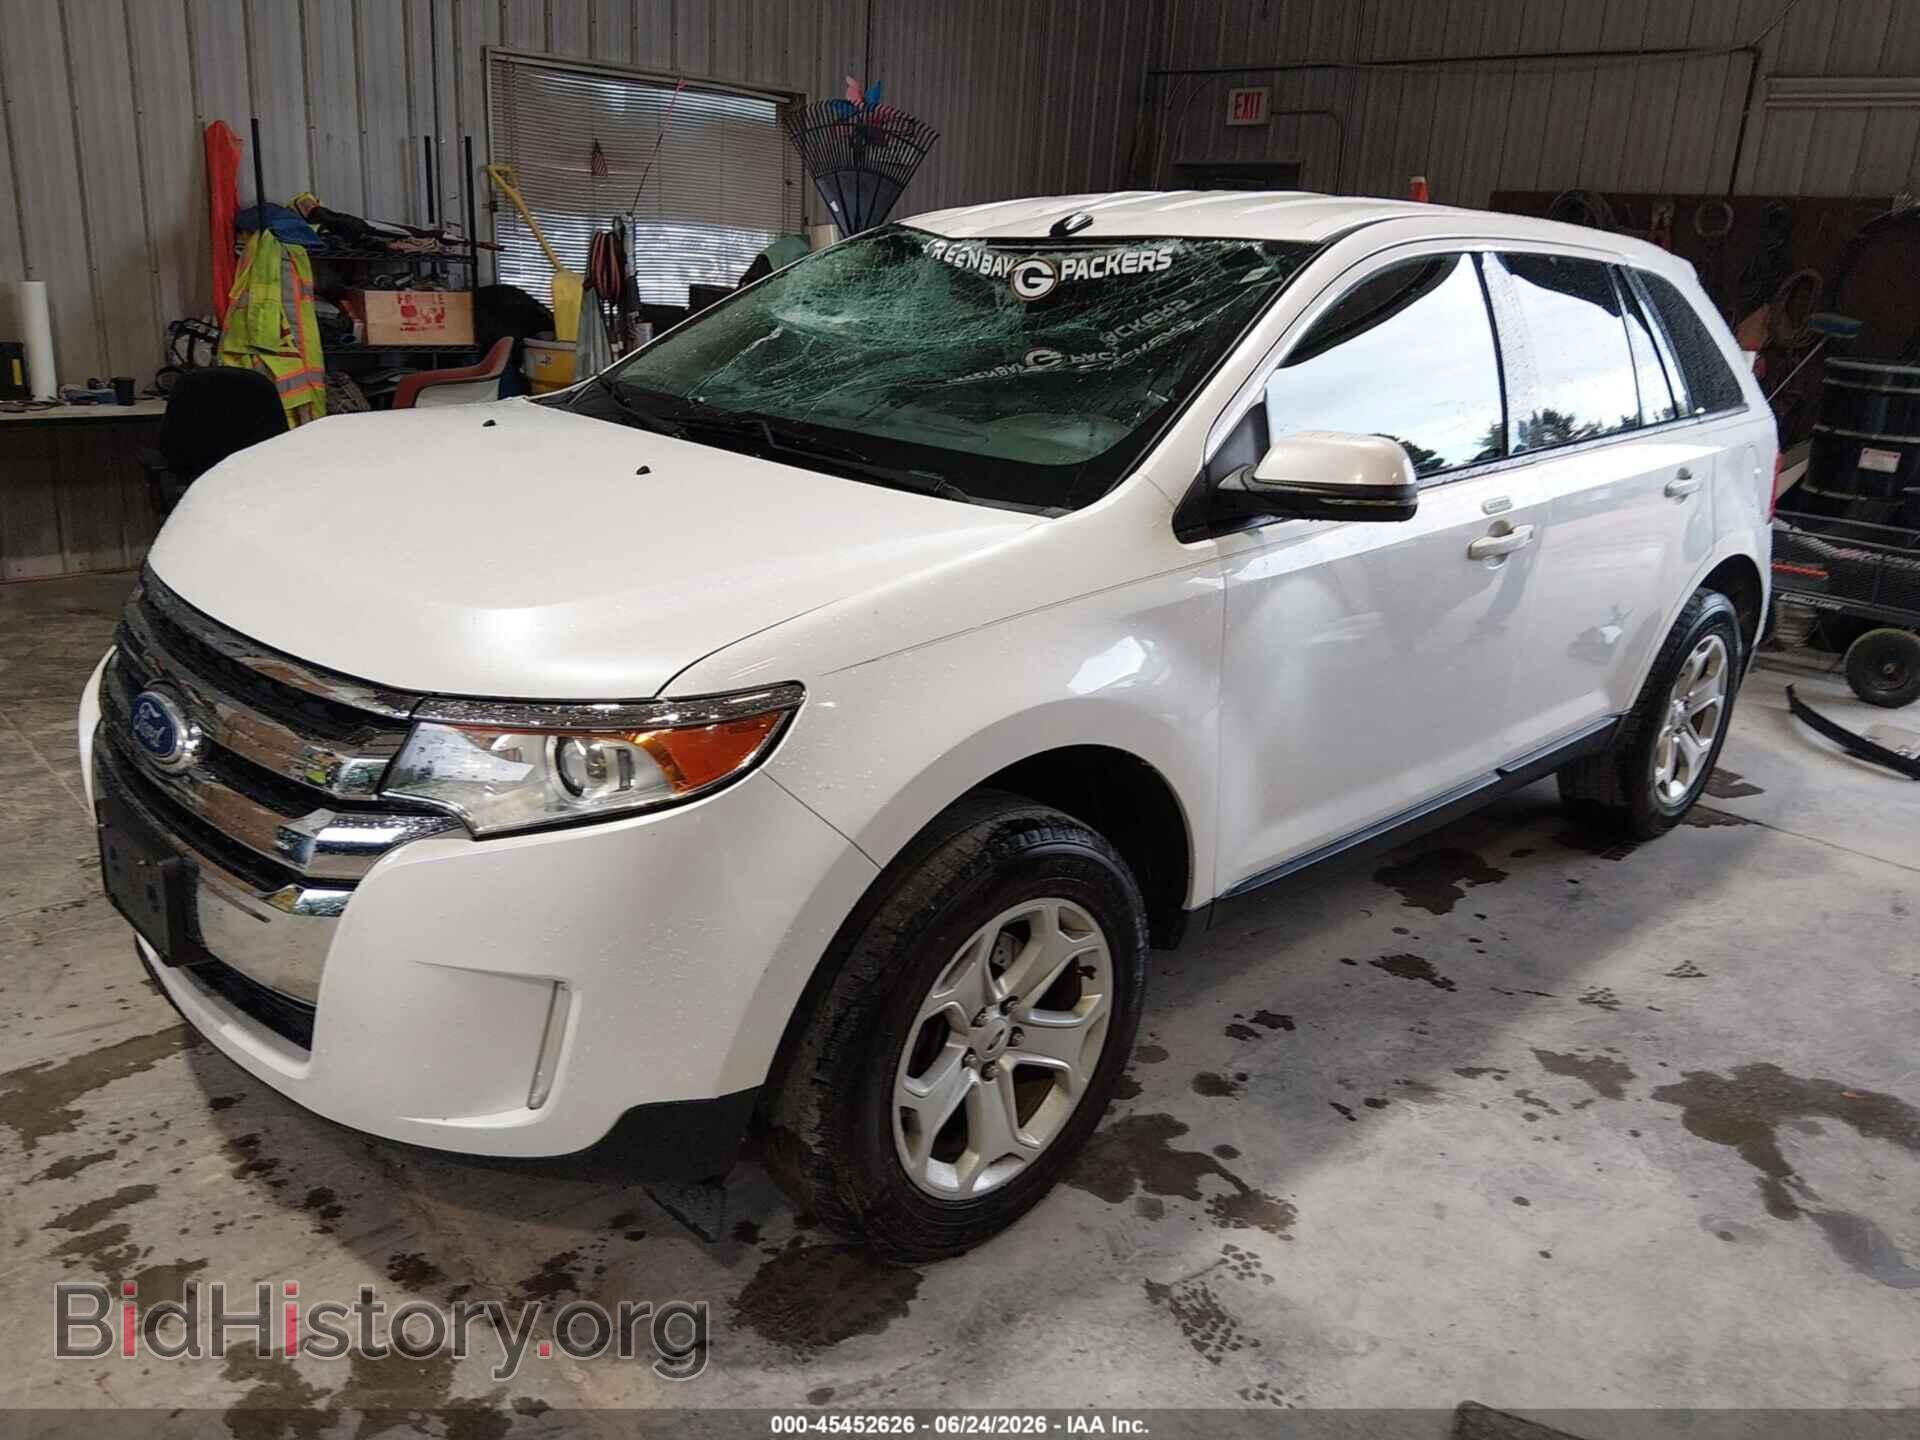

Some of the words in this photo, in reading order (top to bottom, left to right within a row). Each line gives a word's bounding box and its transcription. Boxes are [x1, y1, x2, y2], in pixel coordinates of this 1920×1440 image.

[1232, 91, 1264, 120] EXIT
[1013, 259, 1056, 298] G
[1061, 247, 1175, 280] PACKERS
[133, 702, 165, 747] Ford
